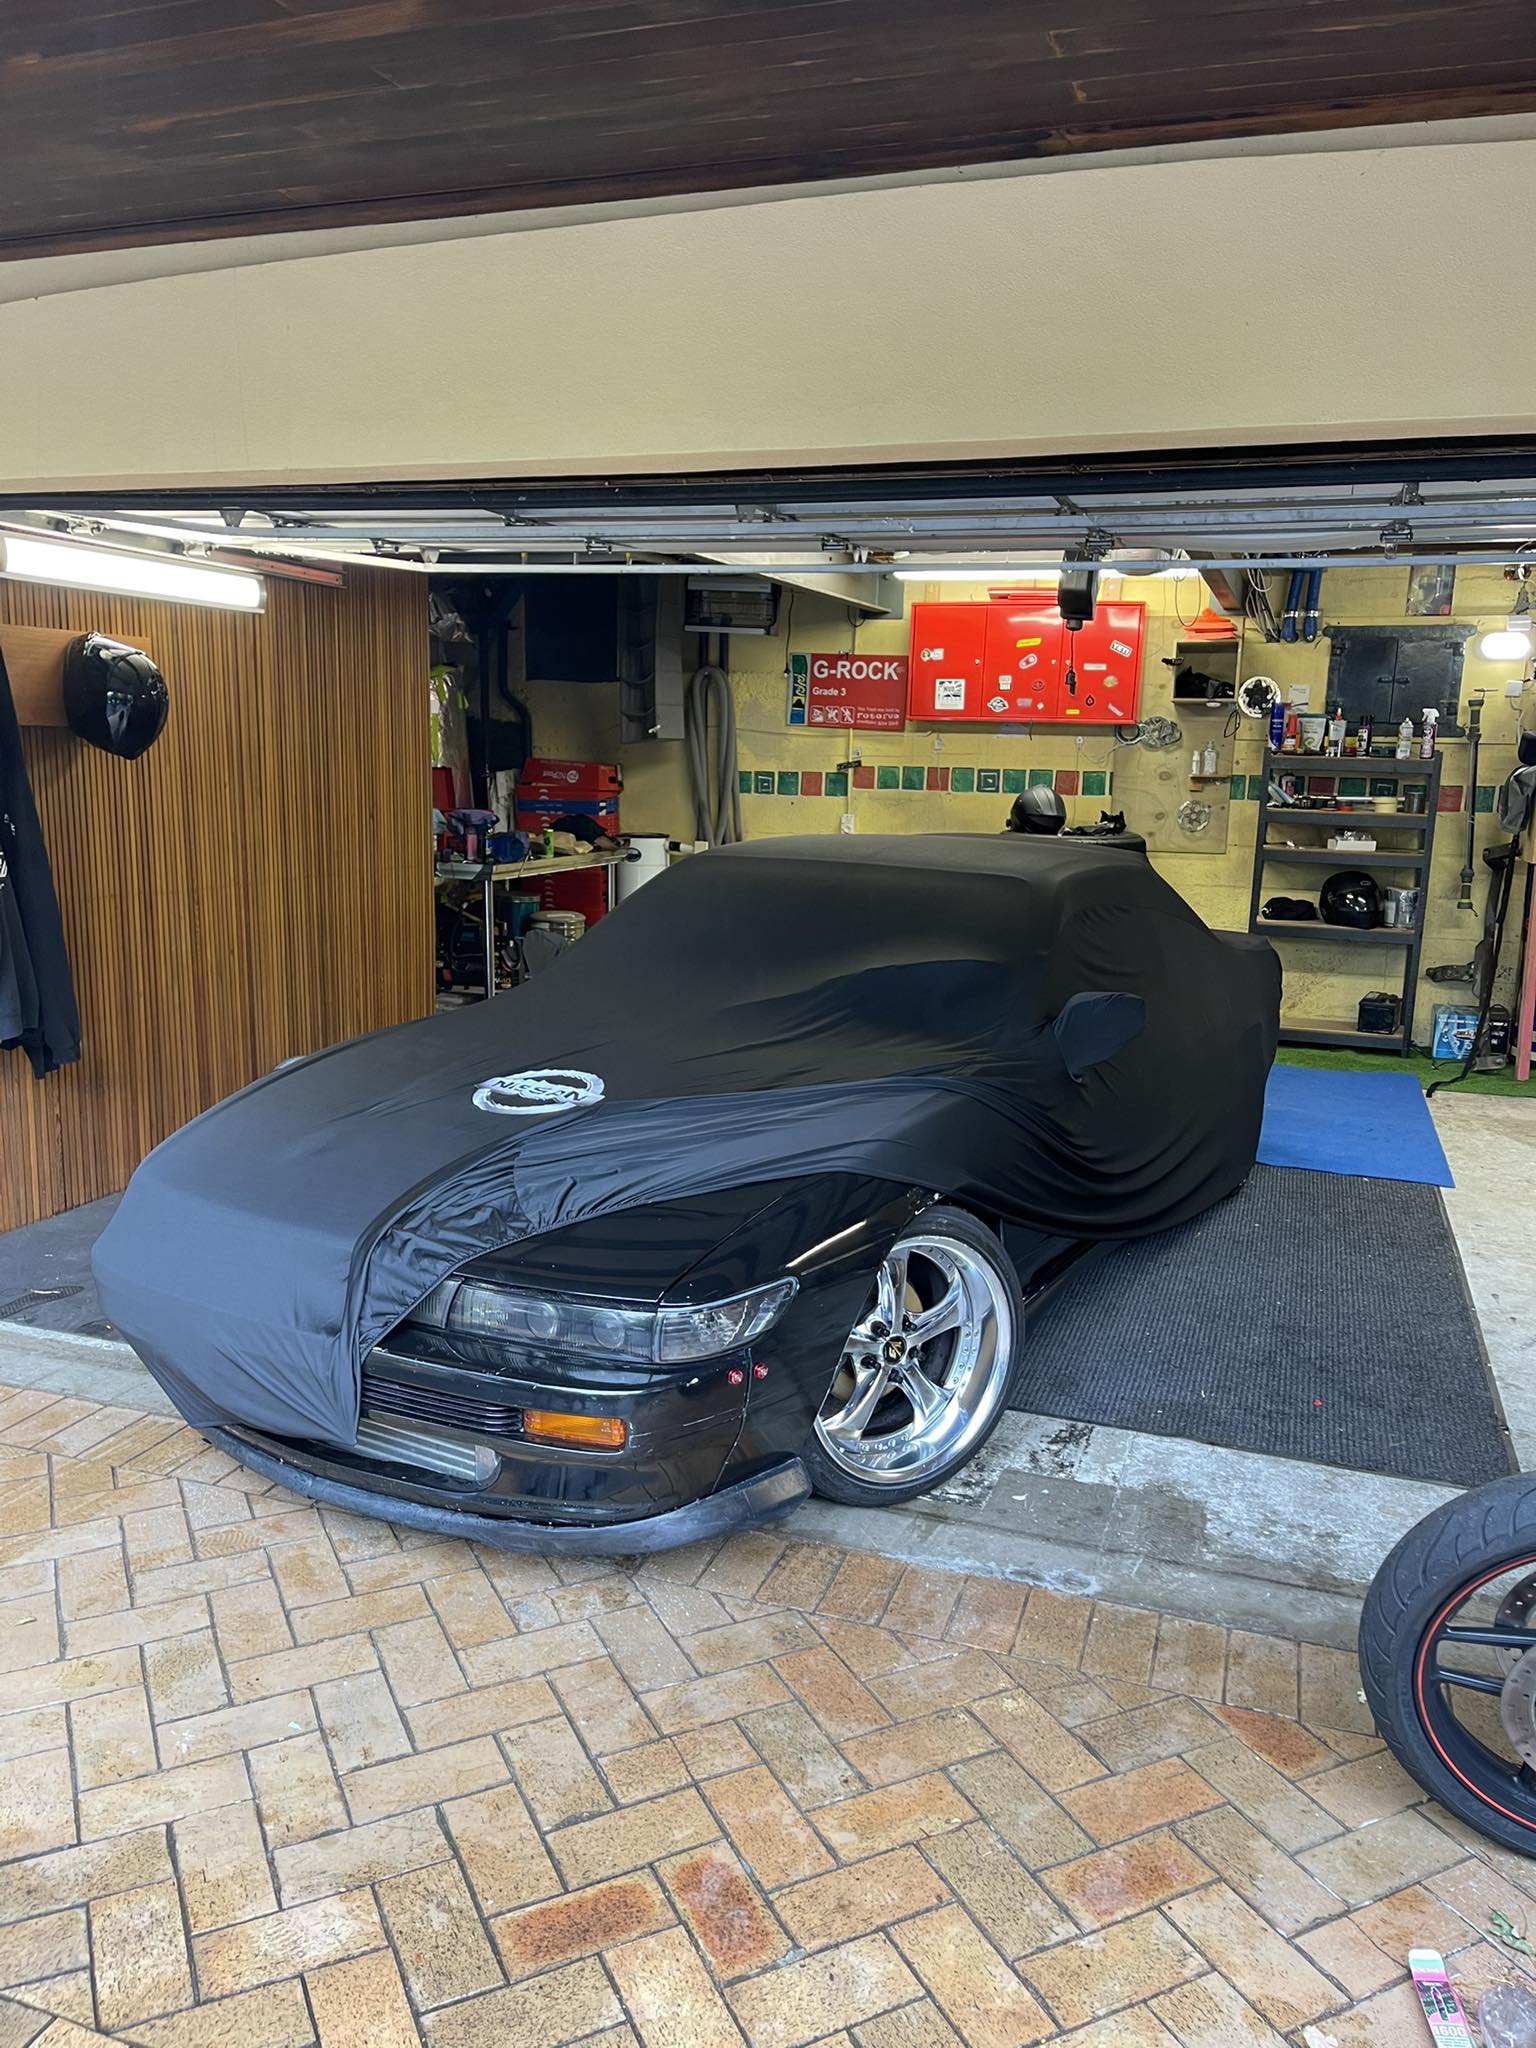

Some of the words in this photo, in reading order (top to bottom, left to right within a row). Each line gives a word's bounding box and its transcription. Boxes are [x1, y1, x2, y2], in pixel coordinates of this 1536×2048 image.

[813, 660, 899, 681] G-ROCK
[812, 687, 839, 696] Grade
[840, 687, 847, 697] 3
[493, 1080, 587, 1102] NISSAN
